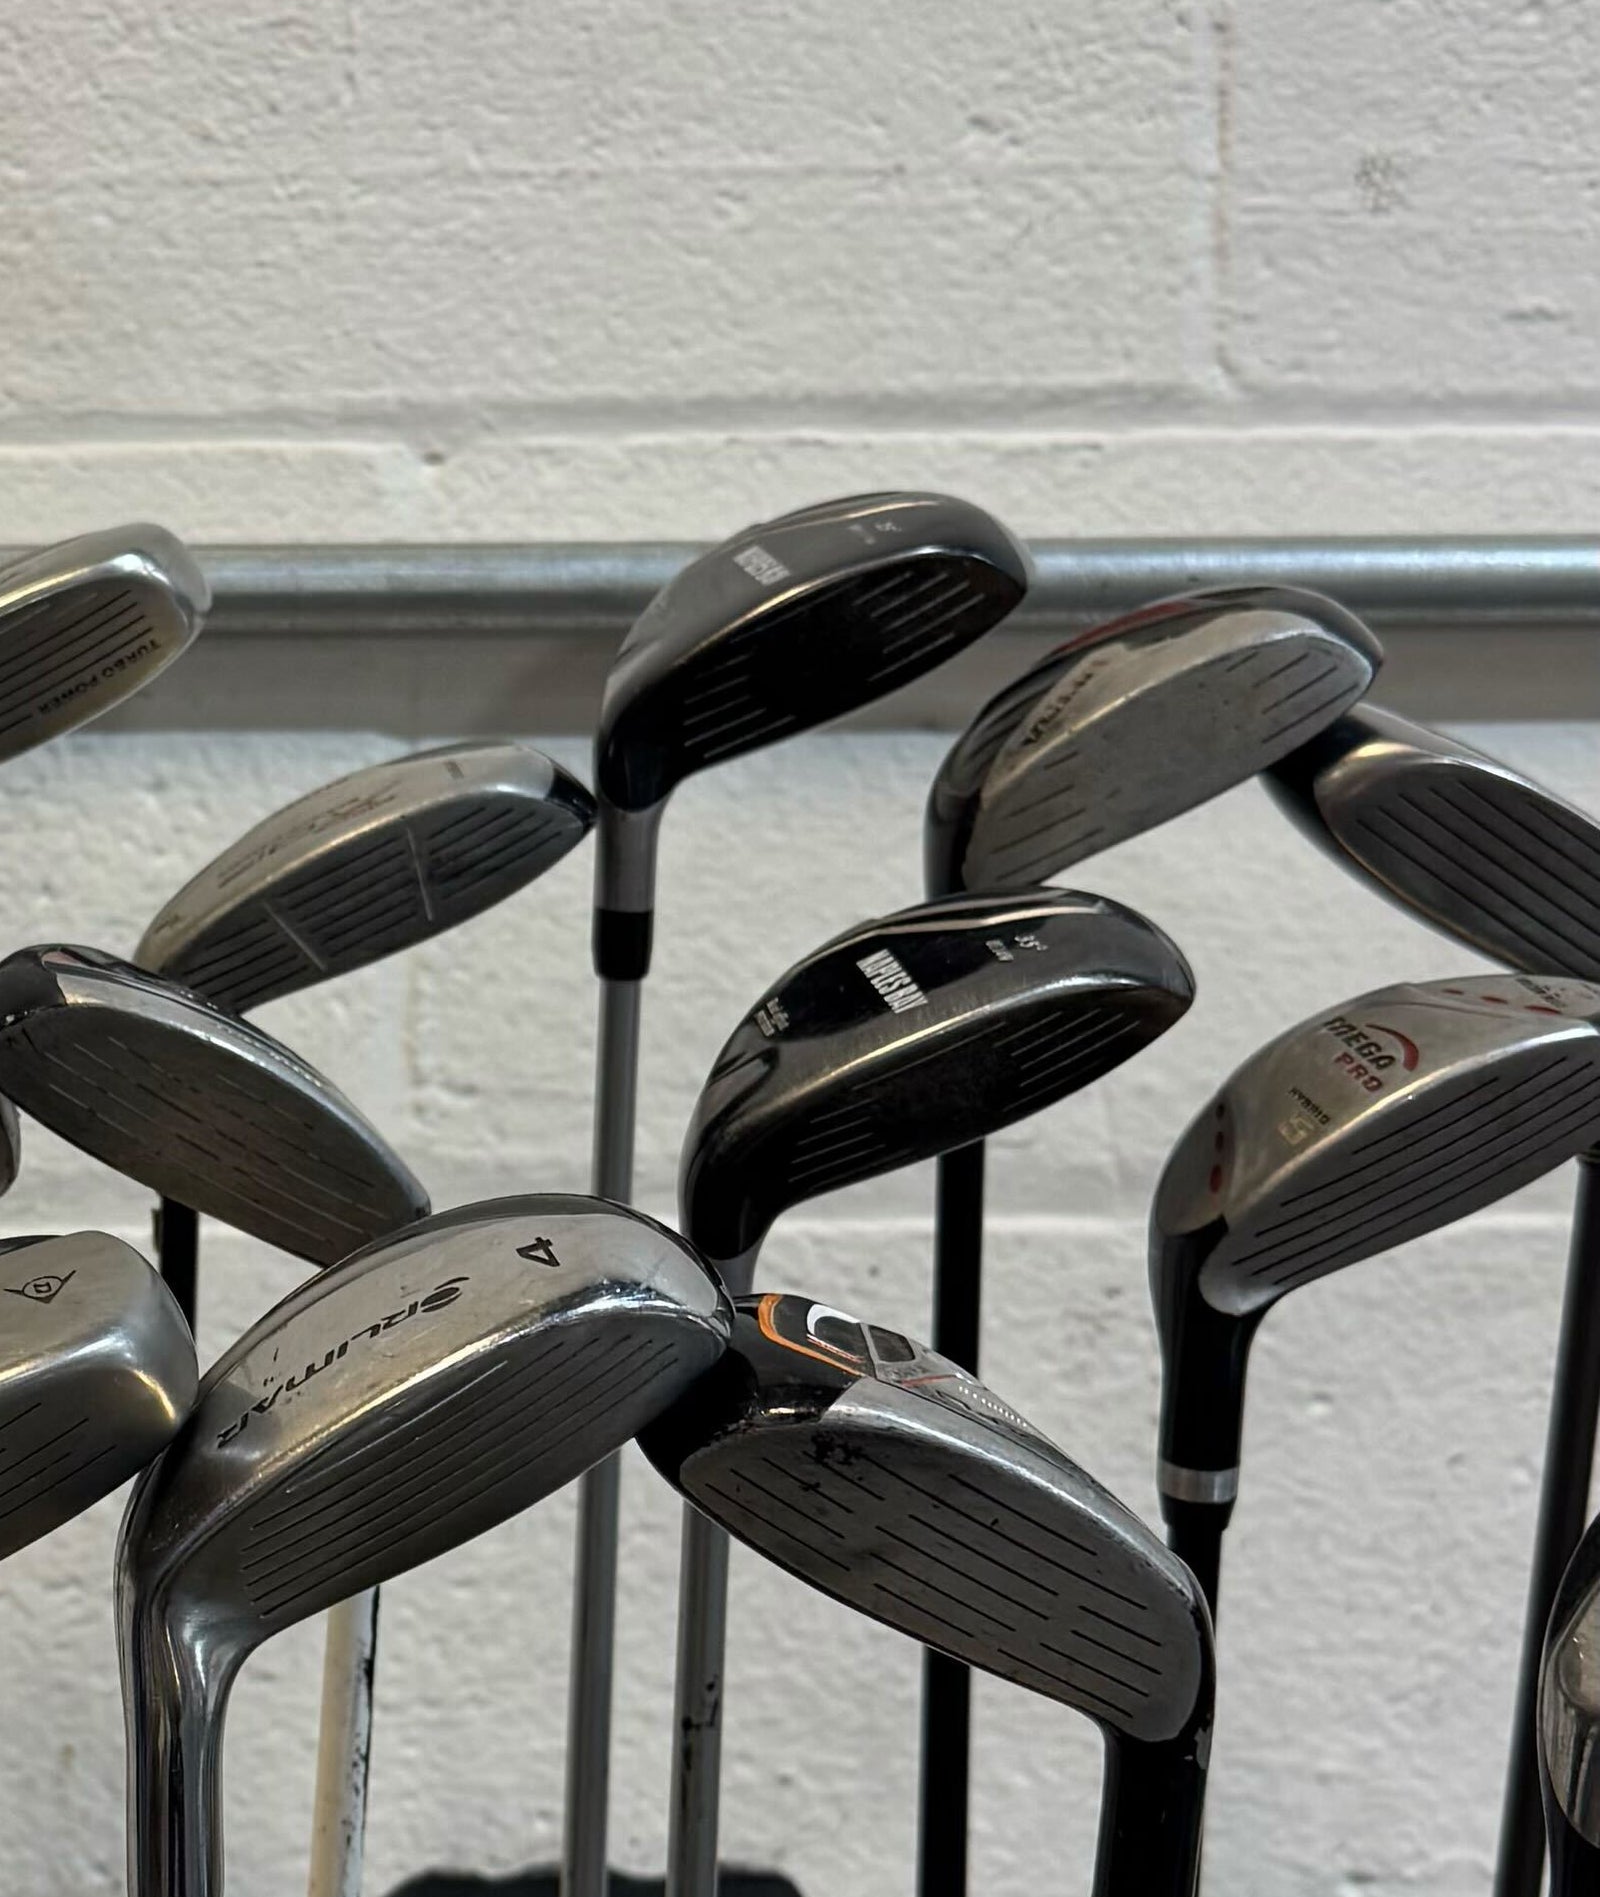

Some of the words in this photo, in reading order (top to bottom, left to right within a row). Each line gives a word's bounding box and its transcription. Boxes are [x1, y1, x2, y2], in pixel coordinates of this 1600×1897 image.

[882, 981, 929, 1015] BAY
[1322, 1015, 1397, 1072] MEGA
[1333, 1051, 1384, 1094] PRO
[514, 1235, 561, 1268] 4
